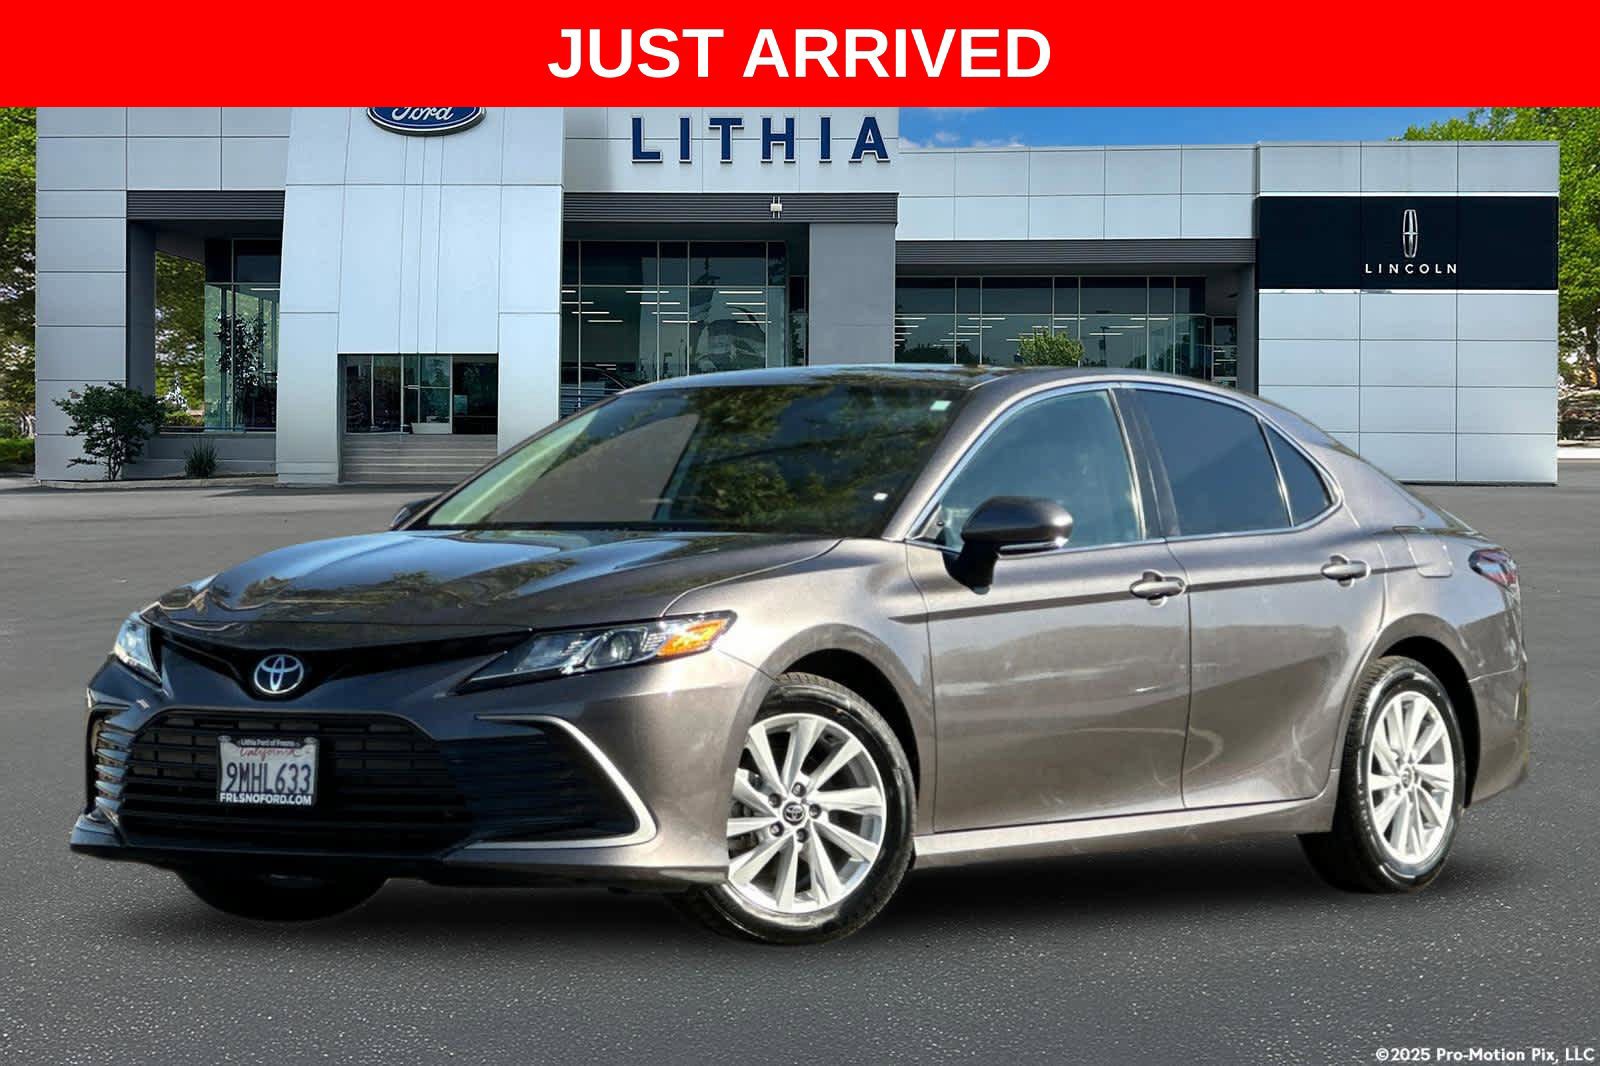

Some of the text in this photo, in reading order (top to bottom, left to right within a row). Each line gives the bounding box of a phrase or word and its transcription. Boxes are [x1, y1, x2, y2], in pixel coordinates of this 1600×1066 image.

[632, 116, 891, 163] LITHIA
[1365, 263, 1457, 274] LINCOLN
[226, 762, 311, 793] 9MHL633
